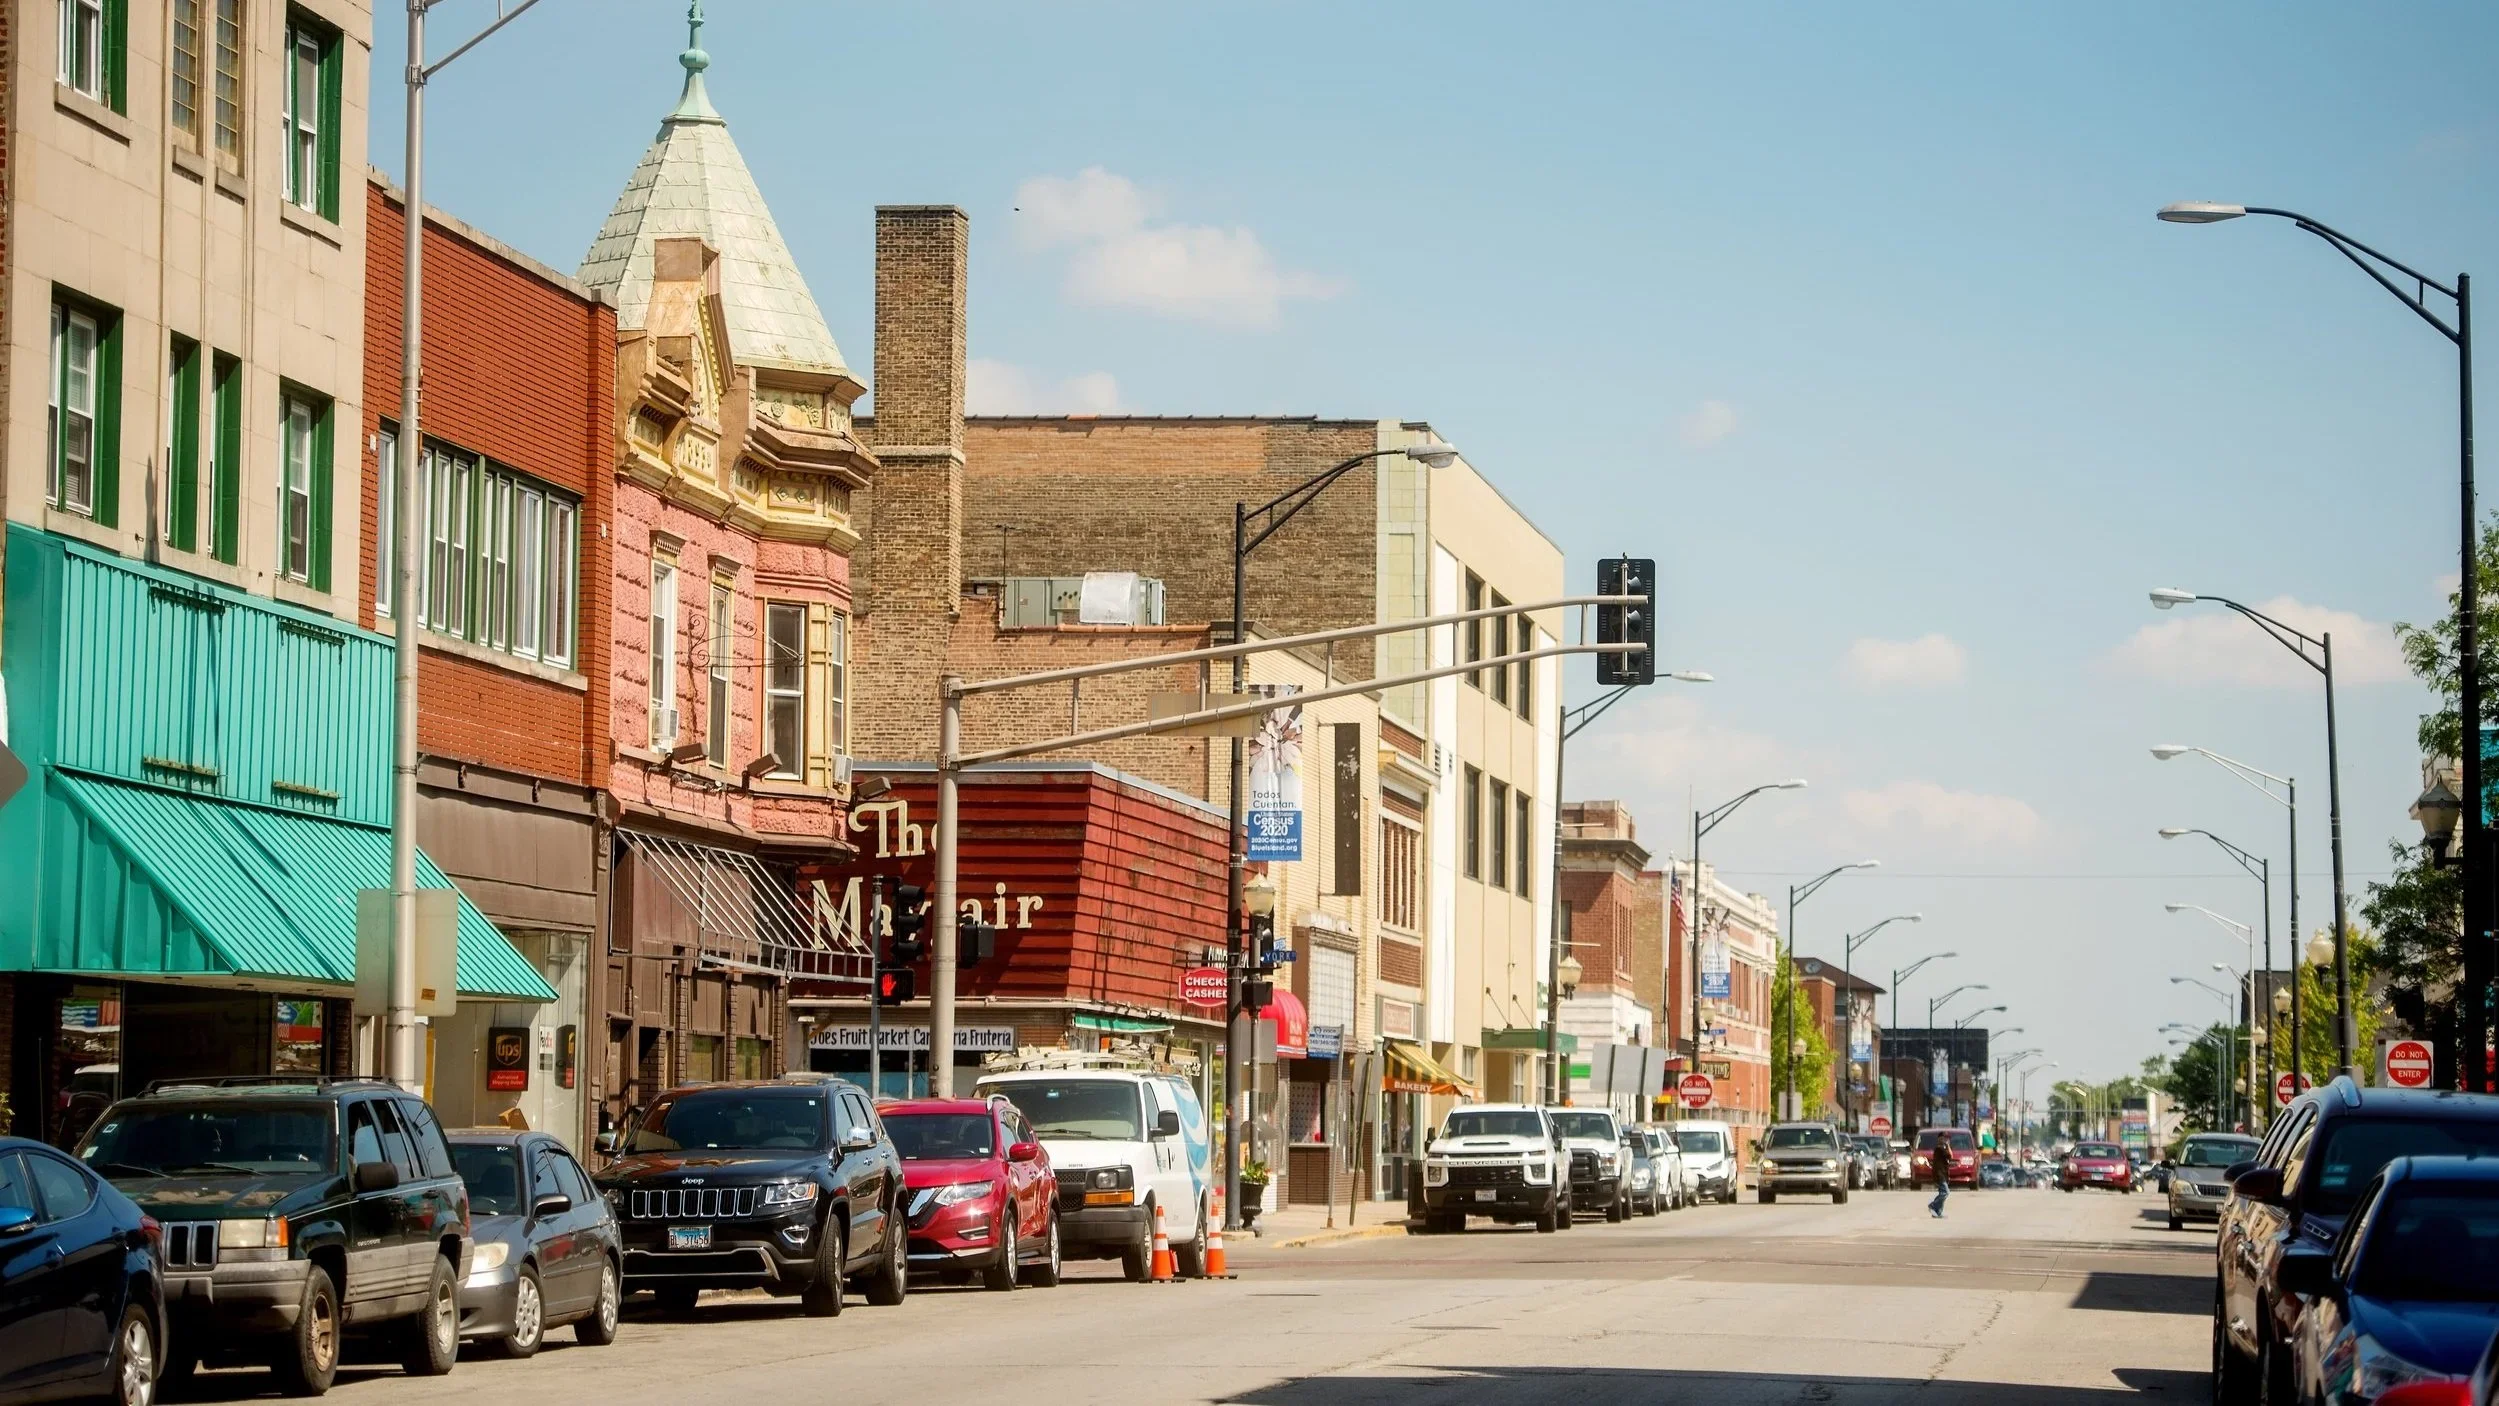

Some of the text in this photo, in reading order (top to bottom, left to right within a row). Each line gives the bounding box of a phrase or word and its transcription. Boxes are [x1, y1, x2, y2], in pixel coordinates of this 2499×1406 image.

[1253, 813, 1294, 825] Census
[1260, 826, 1288, 836] 2020
[811, 877, 1044, 950] Maair
[1265, 952, 1290, 961] YORK
[840, 1028, 867, 1045] Fruit
[497, 1043, 520, 1061] ups
[1394, 1081, 1432, 1092] BAKERY
[682, 1177, 704, 1185] Jeep
